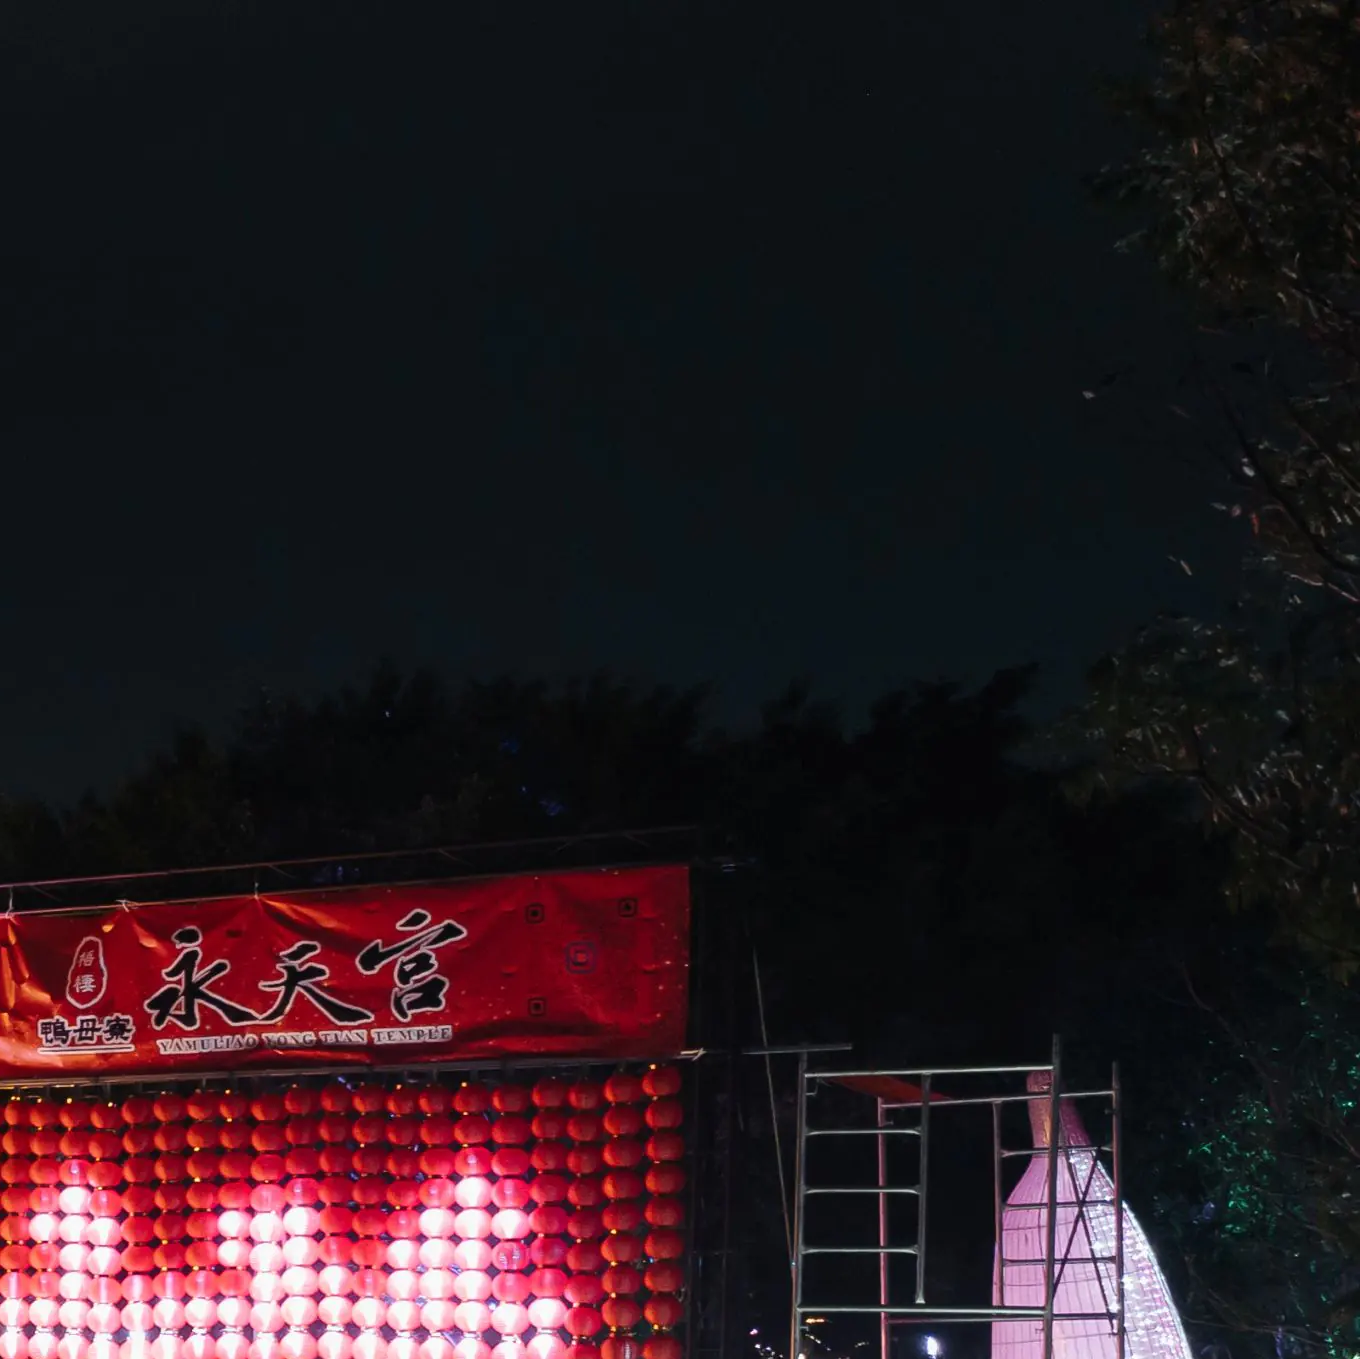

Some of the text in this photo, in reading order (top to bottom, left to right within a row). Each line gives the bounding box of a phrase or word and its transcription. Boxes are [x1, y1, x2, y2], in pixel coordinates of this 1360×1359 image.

[74, 950, 97, 993] 梧棲
[144, 908, 467, 1030] 永天宮
[38, 1013, 136, 1048] 鴨母寮
[156, 1024, 454, 1056] YAMULIAO YONG TIAN TEMPLE
